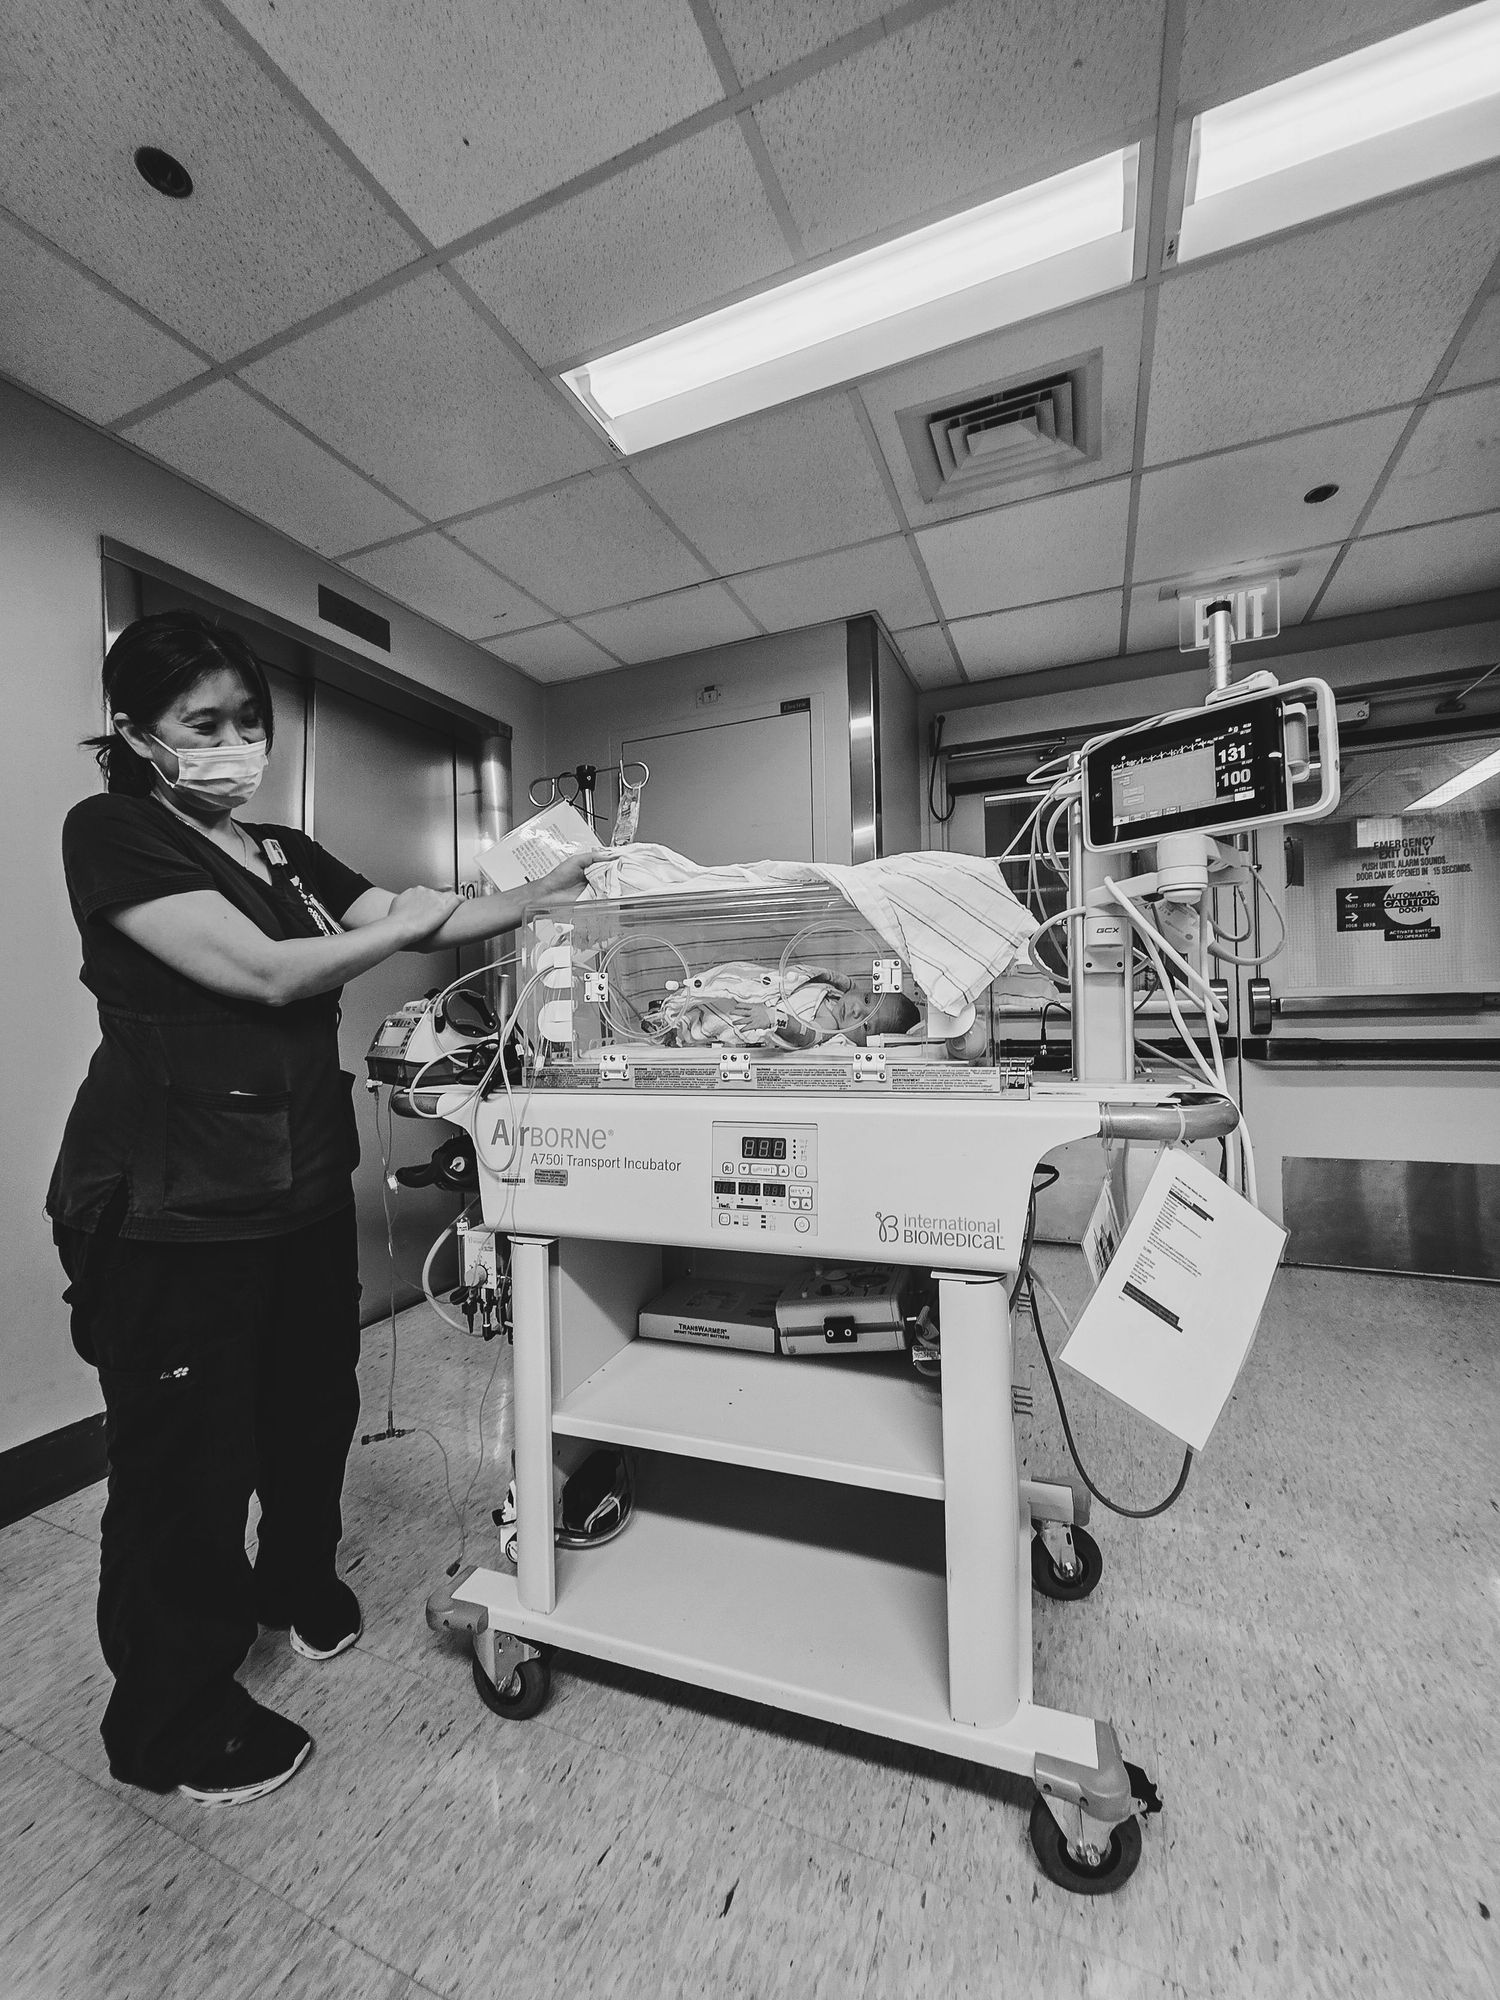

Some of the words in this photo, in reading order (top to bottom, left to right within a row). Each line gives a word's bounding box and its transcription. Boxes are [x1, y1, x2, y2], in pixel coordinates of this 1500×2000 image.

[1218, 744, 1246, 764] 131
[1220, 768, 1251, 788] 100
[1373, 836, 1435, 849] EMERGENCY
[1379, 849, 1401, 860] EXIT
[1403, 846, 1431, 857] ONLY
[1361, 862, 1379, 871] PUSH
[1380, 860, 1397, 870] UNTIL
[1398, 858, 1419, 868] ALARM
[1356, 872, 1373, 881] DOOR
[1374, 871, 1387, 880] CAN
[1387, 870, 1396, 878] BE
[1396, 868, 1421, 878] OPENED
[1421, 867, 1429, 876] IN
[1433, 866, 1441, 875] 15
[460, 883, 476, 899] 10
[1386, 890, 1436, 900] AUTOMATIC
[1384, 896, 1439, 908] CAUTION
[530, 1152, 564, 1166] A750i
[567, 1154, 621, 1171] Transport
[624, 1156, 682, 1172] Incubator
